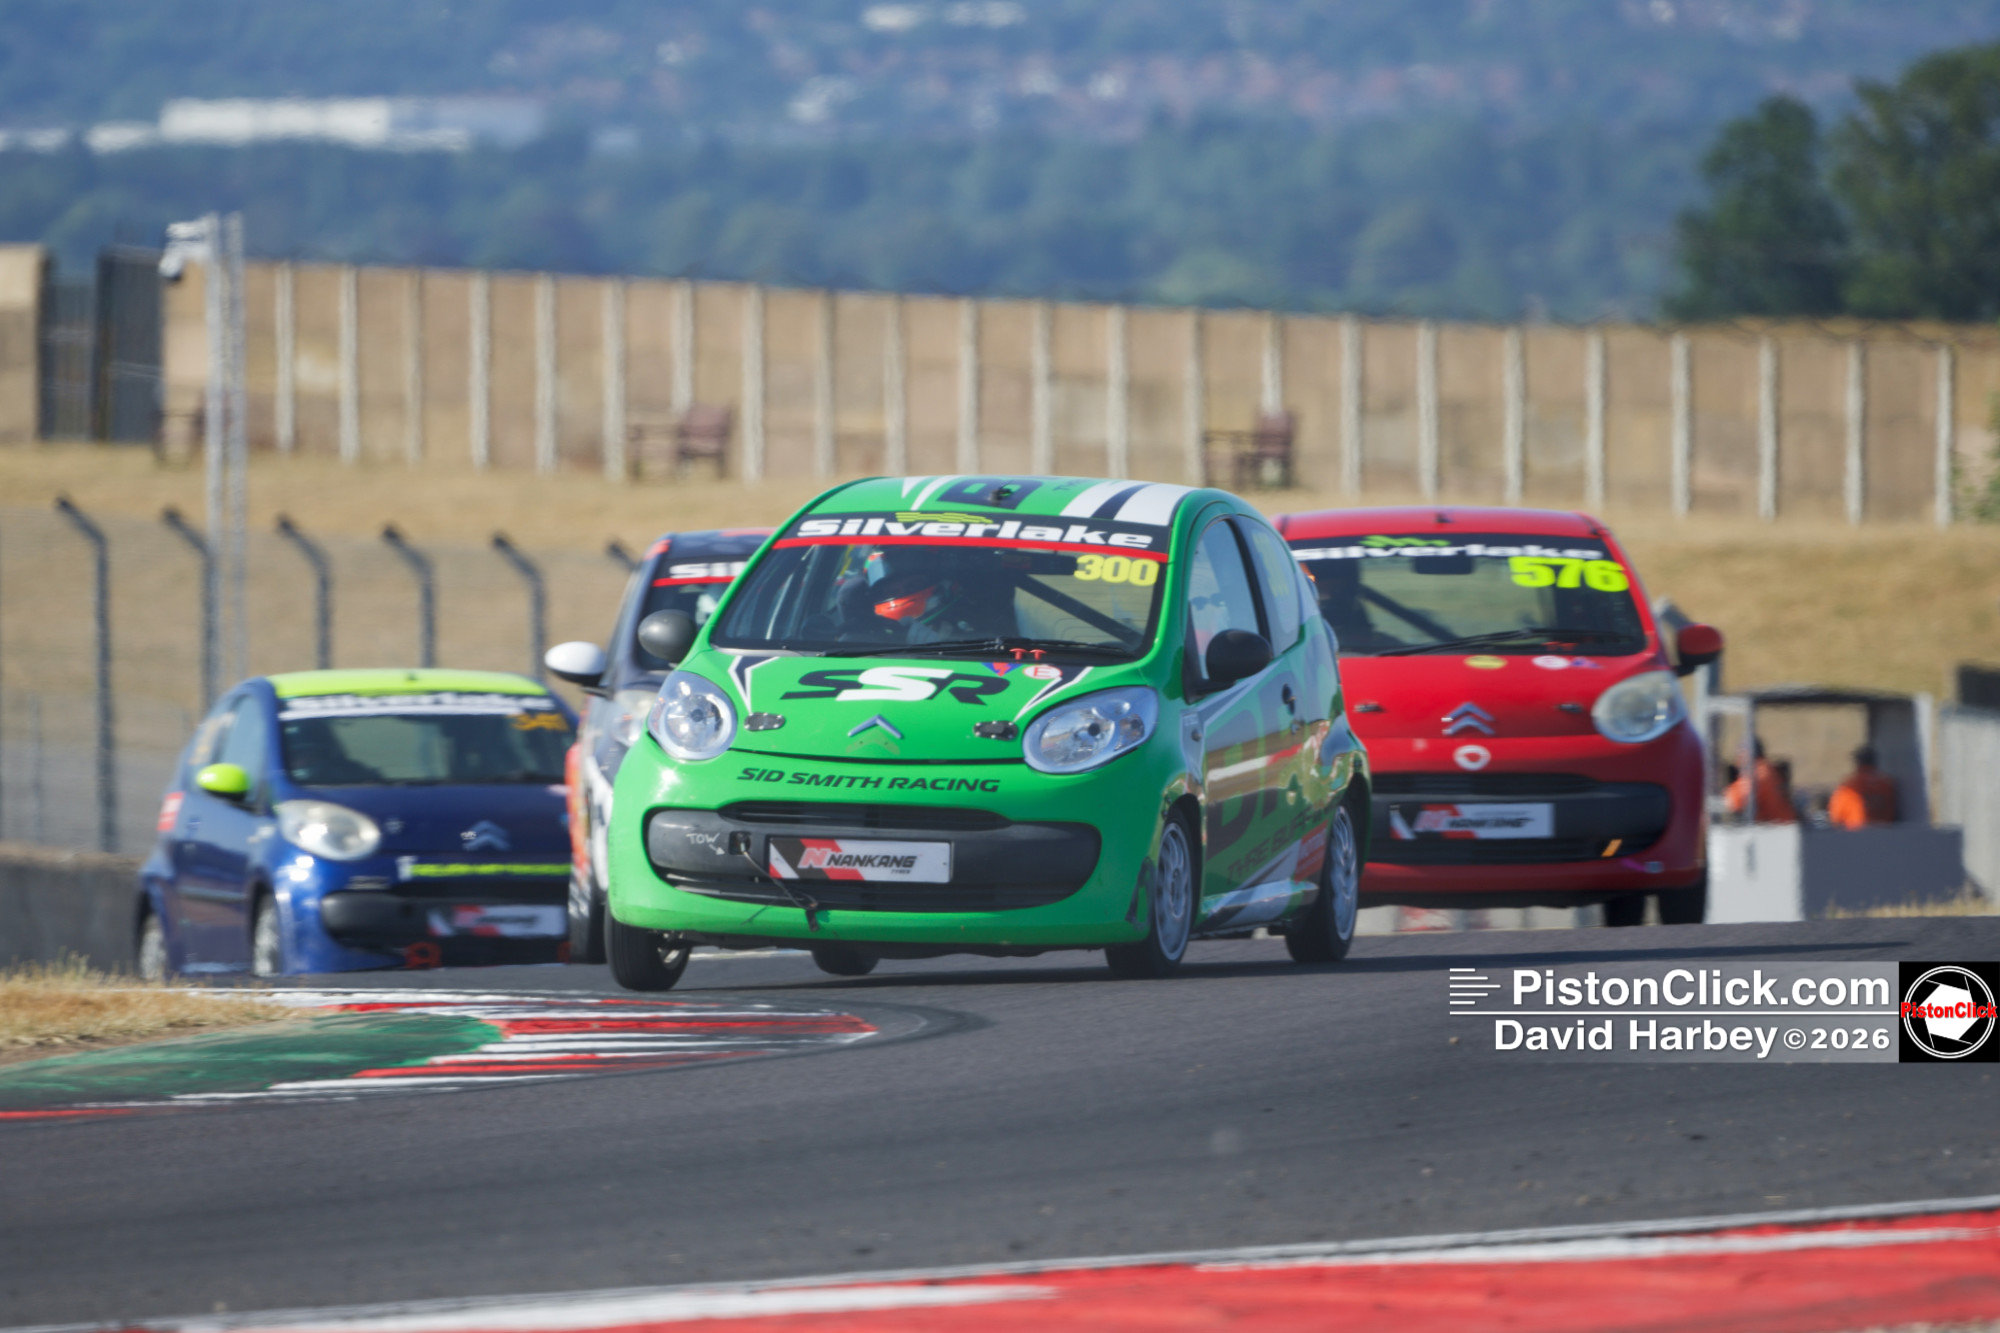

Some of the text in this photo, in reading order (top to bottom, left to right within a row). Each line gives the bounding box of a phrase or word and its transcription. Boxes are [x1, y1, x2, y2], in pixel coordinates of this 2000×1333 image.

[797, 518, 1153, 548] Silverlake
[1074, 554, 1160, 586] 300
[1508, 556, 1630, 592] 576
[781, 666, 1011, 705] SSR
[736, 767, 1001, 793] SID SMITH RACING
[686, 832, 720, 845] TOW
[827, 854, 917, 868] NANKANG
